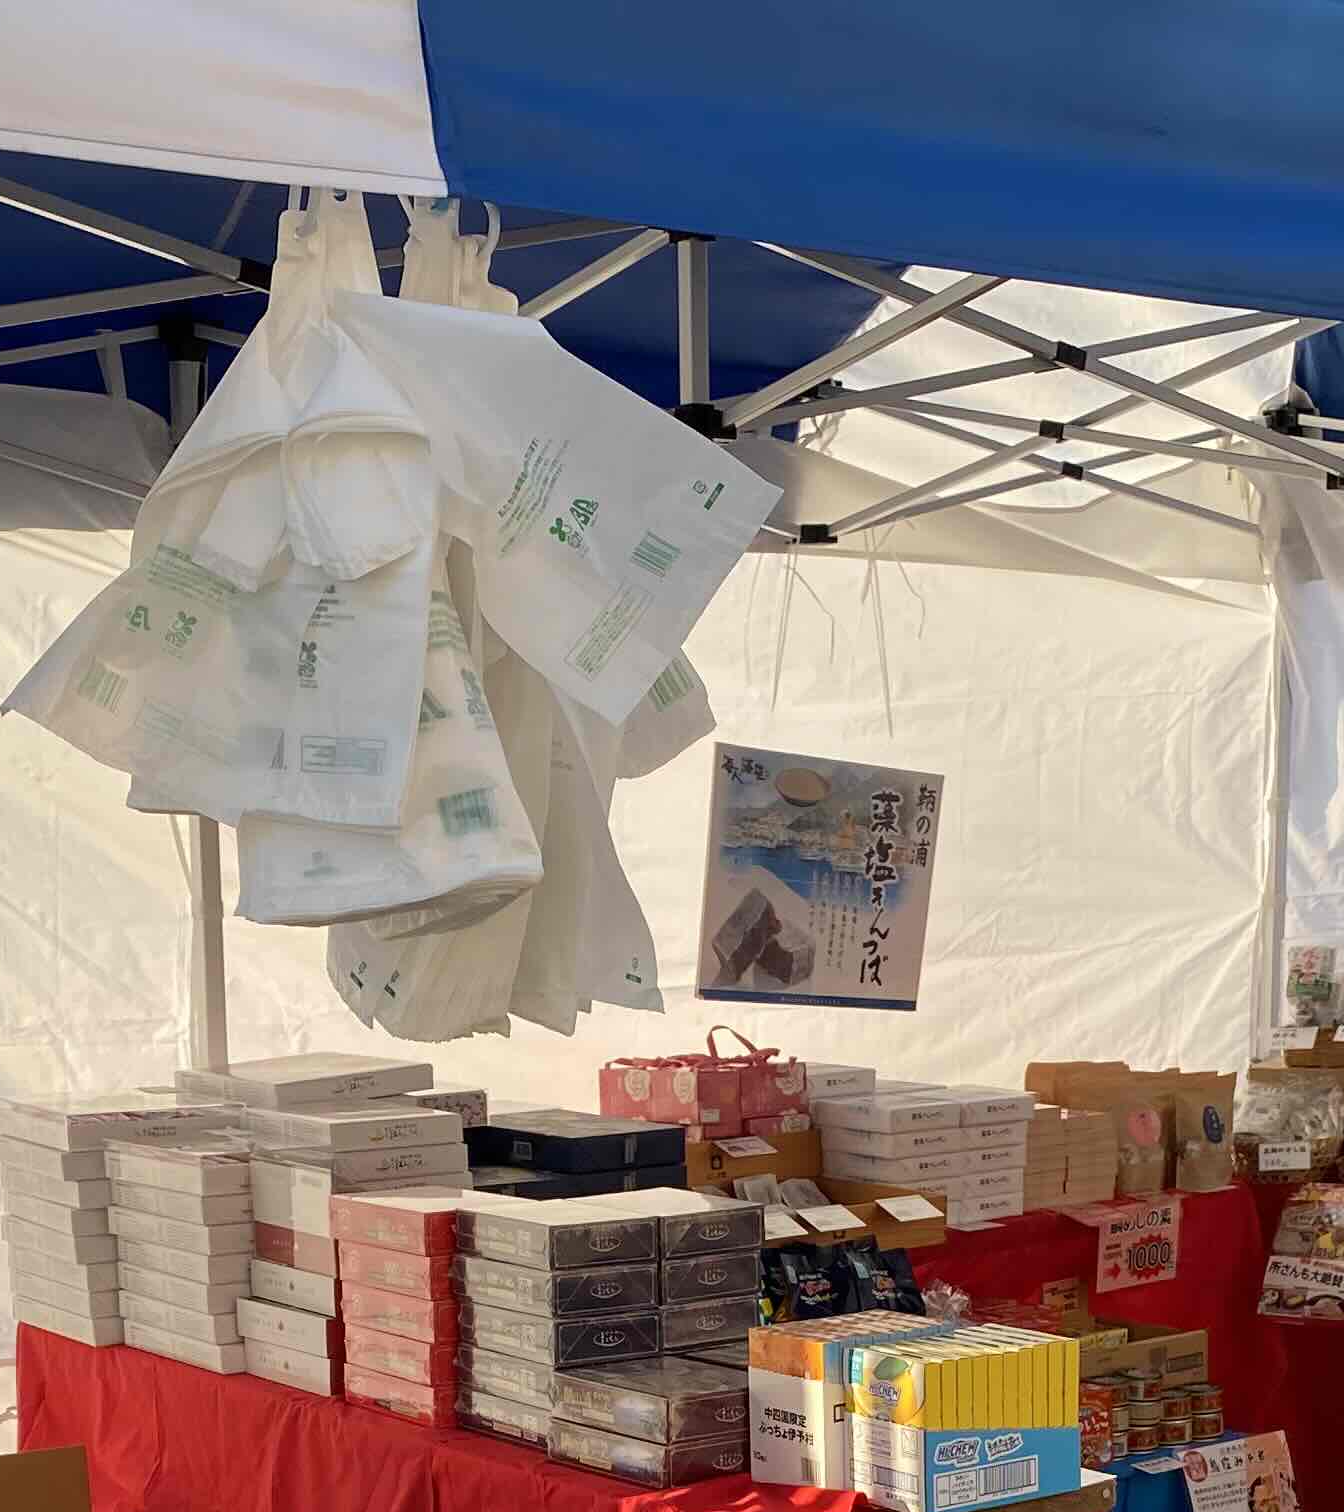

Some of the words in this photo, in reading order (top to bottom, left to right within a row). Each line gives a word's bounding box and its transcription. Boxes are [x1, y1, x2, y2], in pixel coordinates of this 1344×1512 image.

[910, 784, 937, 868] 鞆の浦
[1127, 1241, 1171, 1269] 1000
[764, 1406, 807, 1428] 中四国限定
